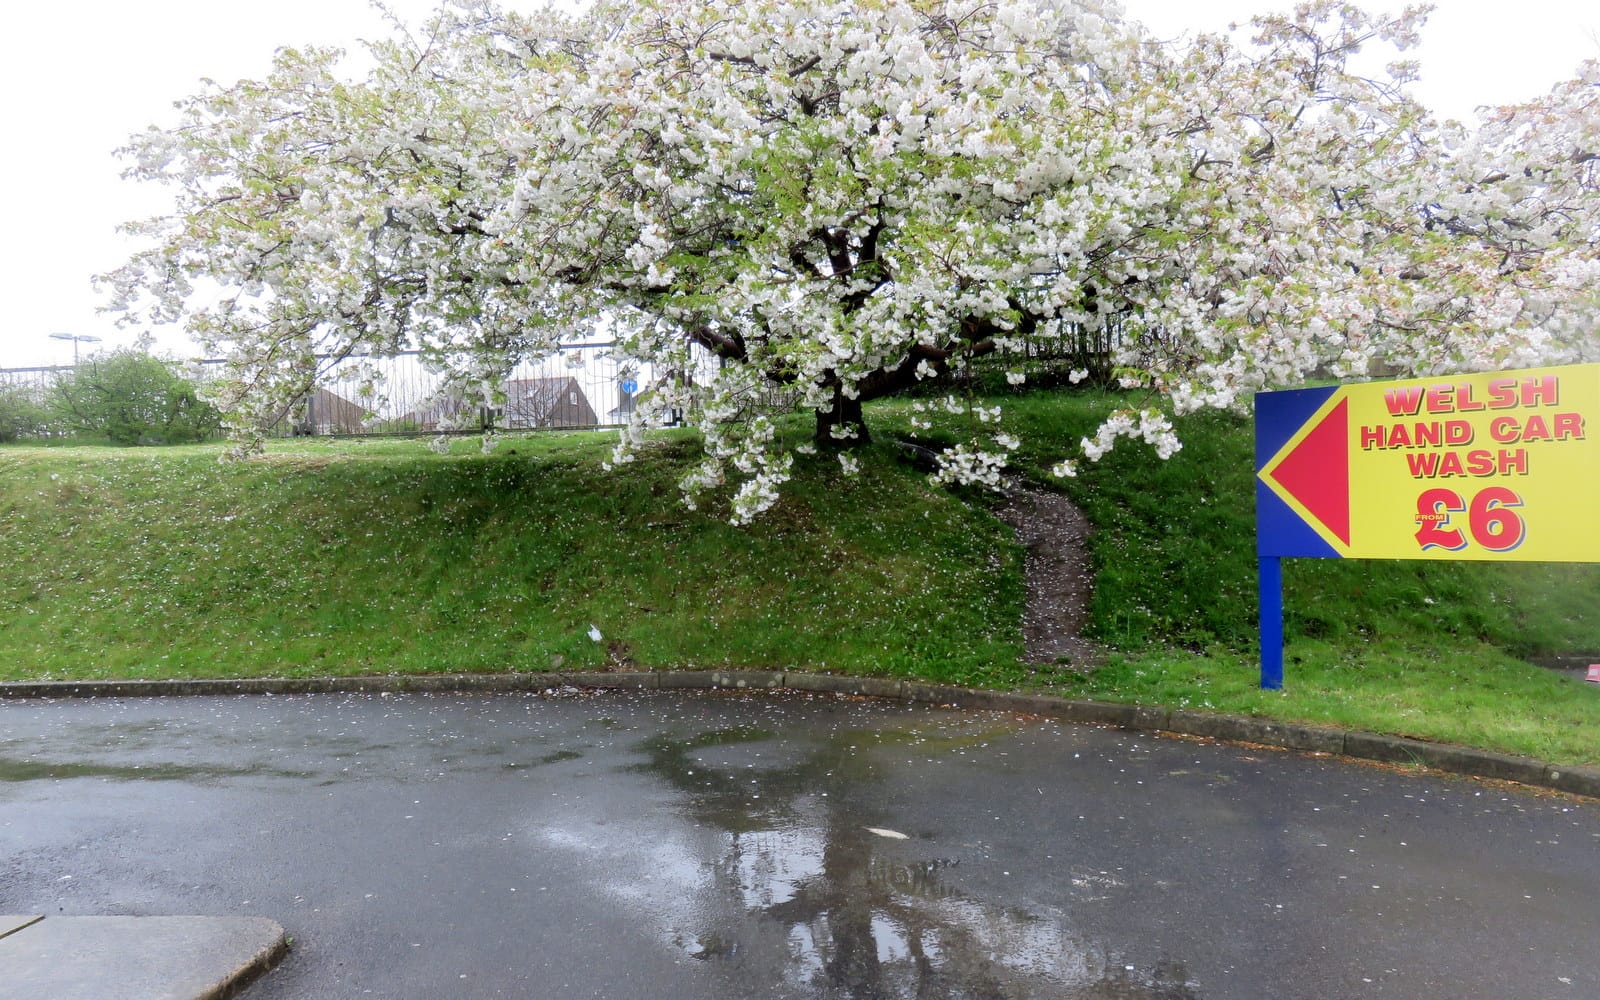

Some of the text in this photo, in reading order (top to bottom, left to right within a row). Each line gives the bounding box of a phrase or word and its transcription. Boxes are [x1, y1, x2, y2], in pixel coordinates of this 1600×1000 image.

[1383, 375, 1558, 417] WELSH
[1360, 412, 1585, 450] HAND CAR
[1406, 448, 1528, 479] WASH
[1414, 486, 1525, 552] £6
